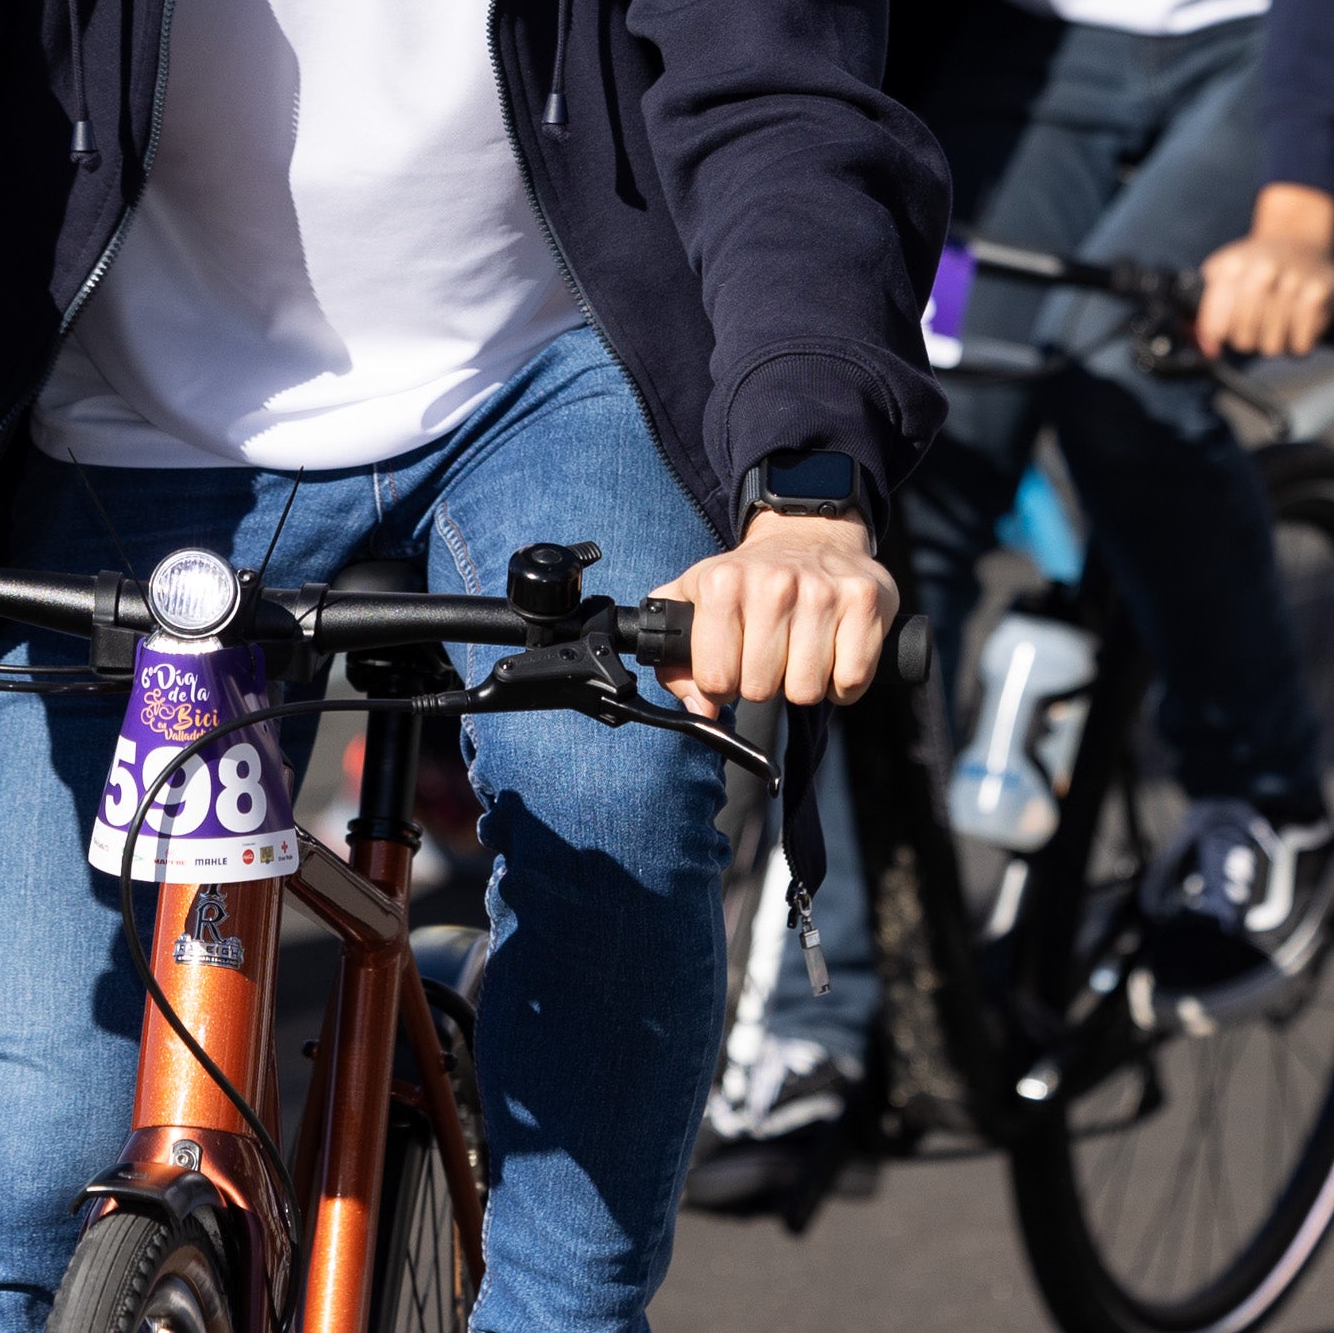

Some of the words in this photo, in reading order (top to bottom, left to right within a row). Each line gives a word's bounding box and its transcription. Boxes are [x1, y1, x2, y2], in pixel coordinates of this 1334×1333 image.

[168, 686, 188, 703] de
[173, 703, 220, 731] Bici
[105, 735, 267, 836] 598
[195, 857, 228, 866] MAHLE
